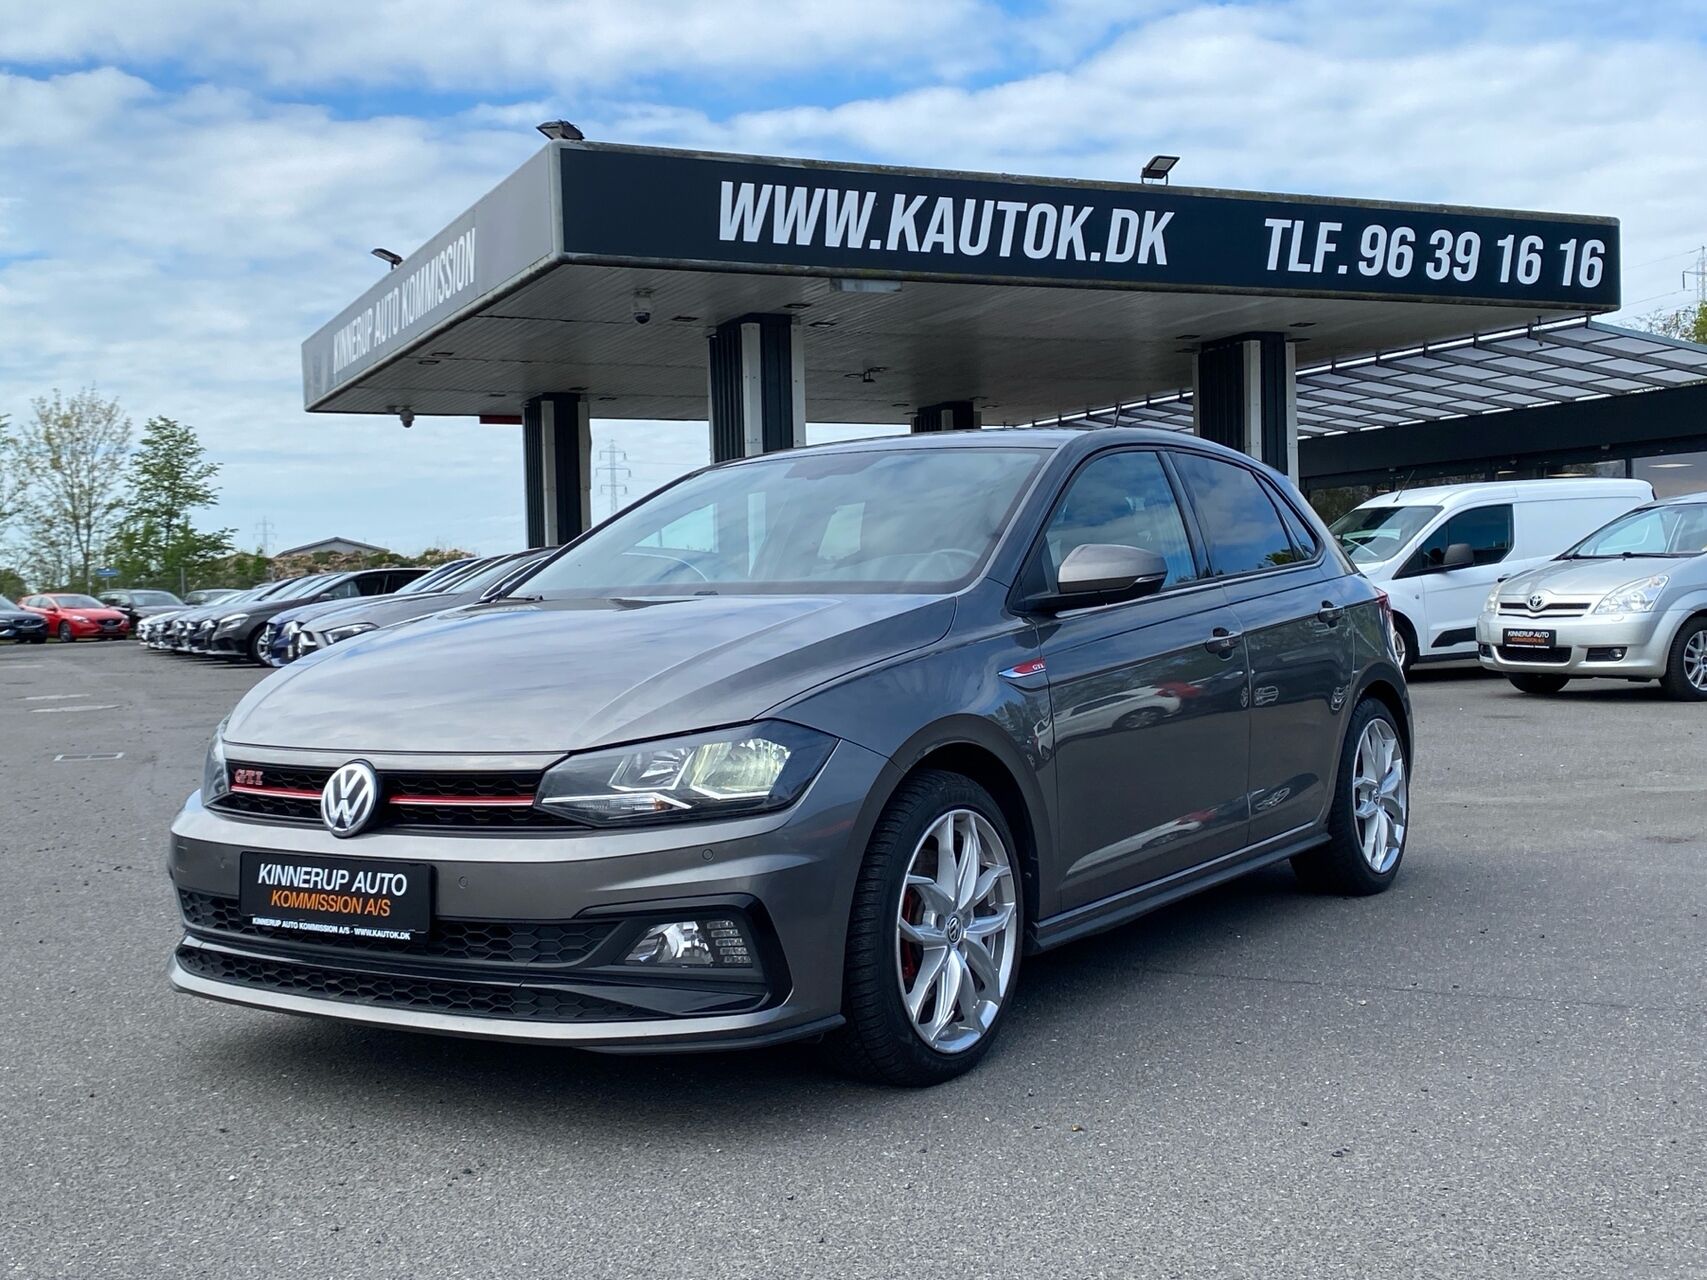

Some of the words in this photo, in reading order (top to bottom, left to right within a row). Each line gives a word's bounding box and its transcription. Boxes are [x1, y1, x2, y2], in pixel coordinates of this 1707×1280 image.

[718, 180, 1176, 266] WWW.KAUTOK.DK
[1264, 218, 1348, 275] TLF.
[1358, 224, 1416, 278] 96
[1425, 229, 1482, 282] 39
[1497, 233, 1544, 285] 16
[1559, 238, 1606, 289] 16
[333, 308, 373, 374] KINNERUP
[373, 286, 400, 348] AUTO
[401, 227, 476, 330] KOMMISSION
[234, 769, 264, 786] GTI
[257, 863, 349, 891] KINNERUP
[351, 871, 408, 896] AUTO
[271, 889, 363, 915] KOMMISSION
[364, 898, 392, 917] A/S
[252, 916, 282, 927] KINNERUP
[282, 920, 299, 930] AUTO
[299, 922, 338, 934] KOMMISSION
